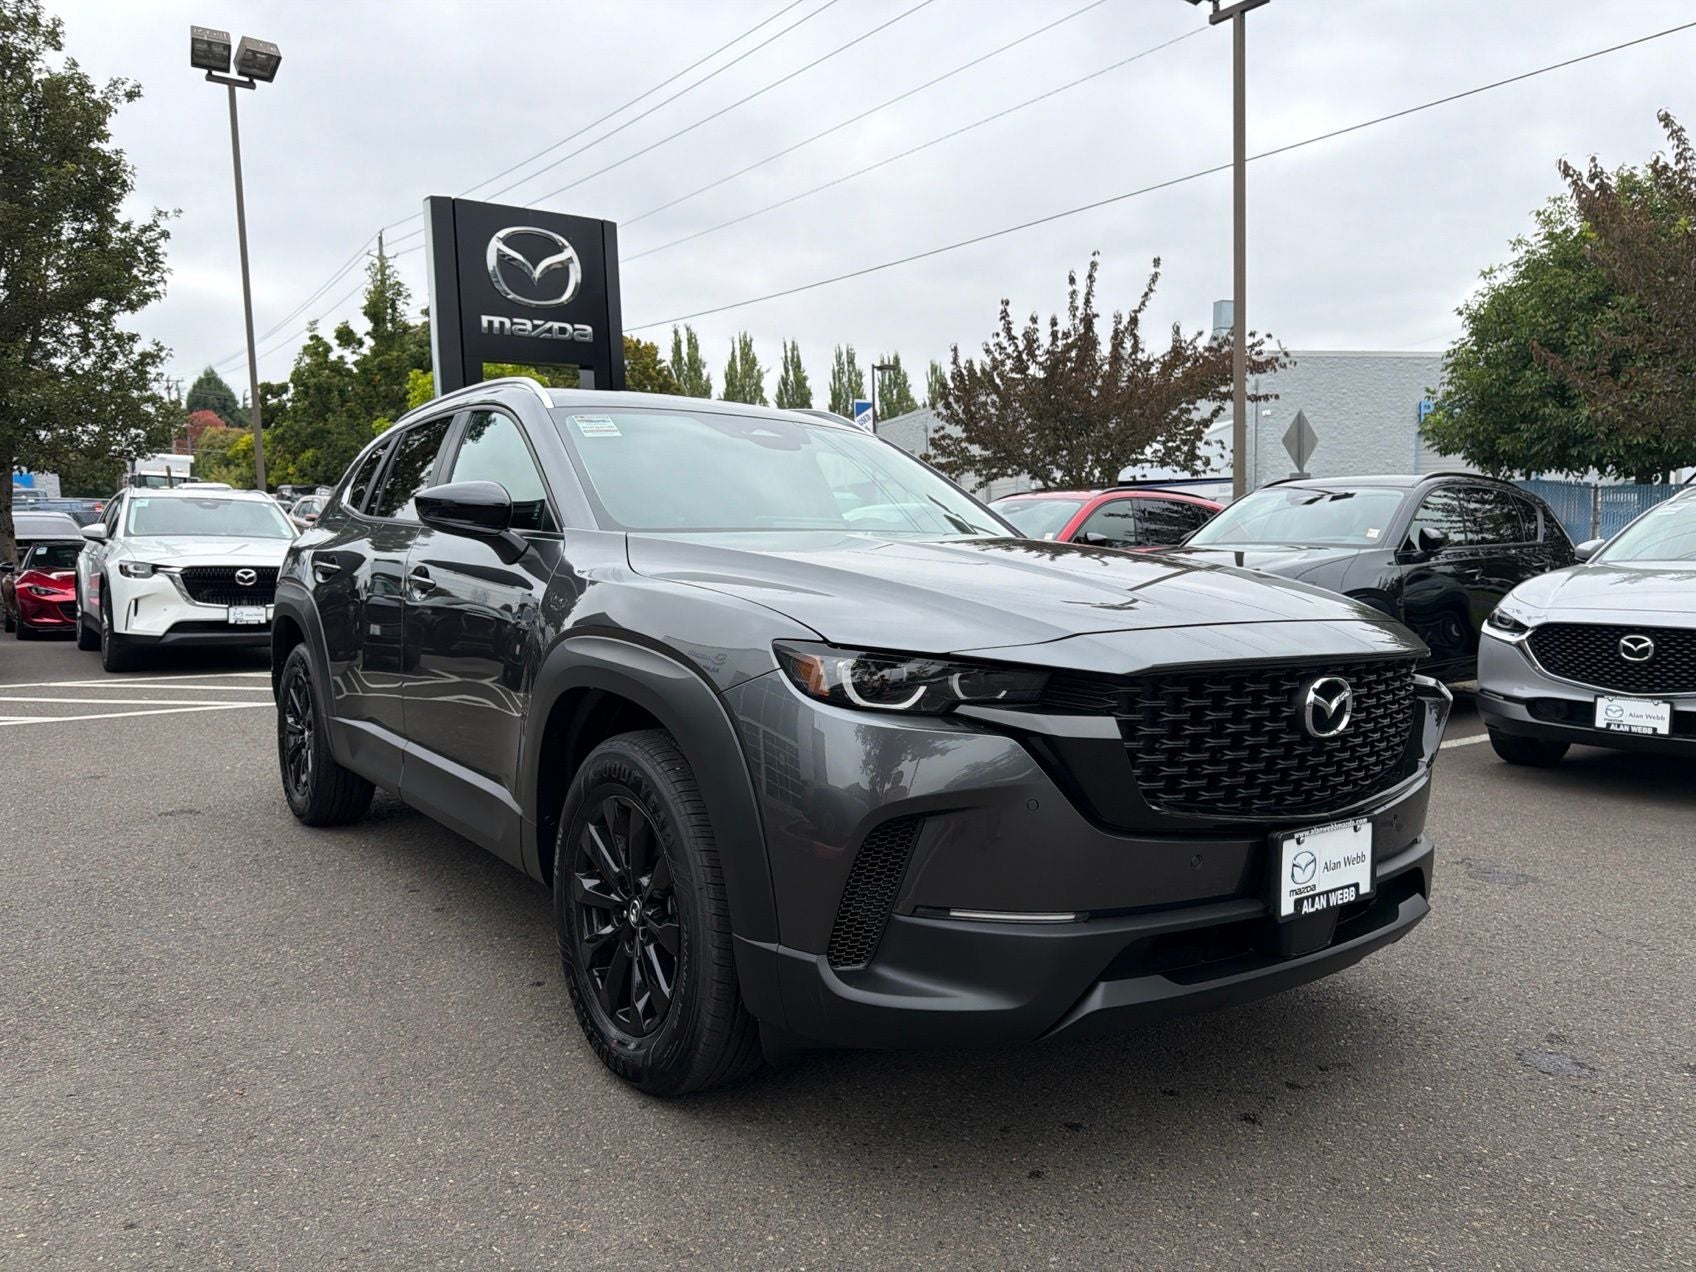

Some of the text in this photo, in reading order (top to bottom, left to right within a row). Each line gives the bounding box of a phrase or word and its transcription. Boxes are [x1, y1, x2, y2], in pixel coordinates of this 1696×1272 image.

[1609, 723, 1654, 734] ALAN WEBB
[1322, 852, 1366, 874] Alan Webb
[1301, 886, 1356, 915] ALAN WEBB
